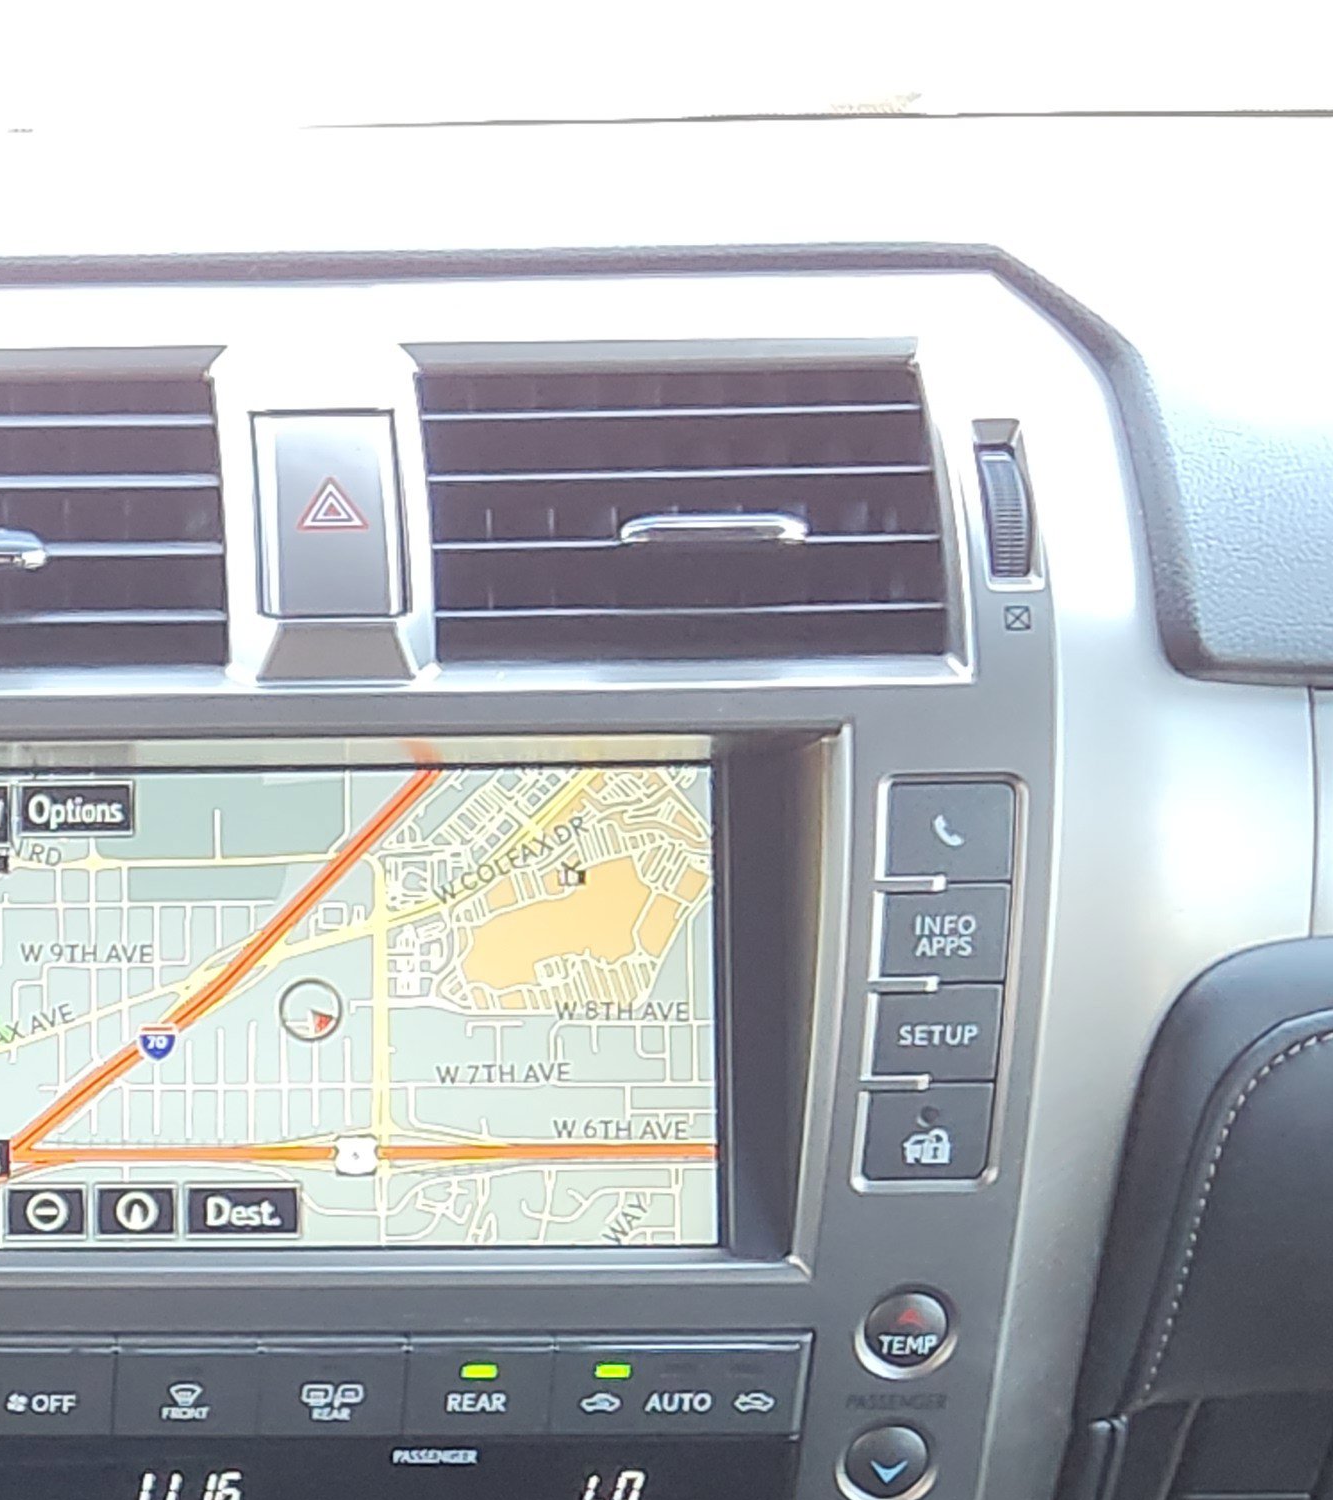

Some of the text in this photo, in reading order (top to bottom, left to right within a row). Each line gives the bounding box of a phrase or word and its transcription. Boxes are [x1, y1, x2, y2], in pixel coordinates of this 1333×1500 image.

[27, 793, 124, 829] Options
[28, 842, 62, 867] RD
[433, 815, 590, 905] W COLFAX DR
[914, 914, 977, 936] INFO
[20, 942, 154, 964] W 9TH AVE
[915, 936, 973, 958] APPS
[30, 1002, 76, 1036] AVE
[555, 1001, 691, 1022] W 8TH AVE
[144, 1034, 169, 1051] 70
[897, 1024, 979, 1046] SETUP
[435, 1062, 572, 1084] W 7TH AVE
[552, 1118, 689, 1140] W 6TH AVE
[205, 1195, 283, 1228] Dest.
[603, 1193, 649, 1246] WAY
[877, 1333, 939, 1356] TEMP
[31, 1394, 78, 1414] OFF
[160, 1406, 210, 1421] FRONT
[445, 1393, 506, 1413] REAR
[643, 1393, 713, 1413] AUTO
[311, 1407, 351, 1422] REAR
[391, 1449, 478, 1465] PASSENGER
